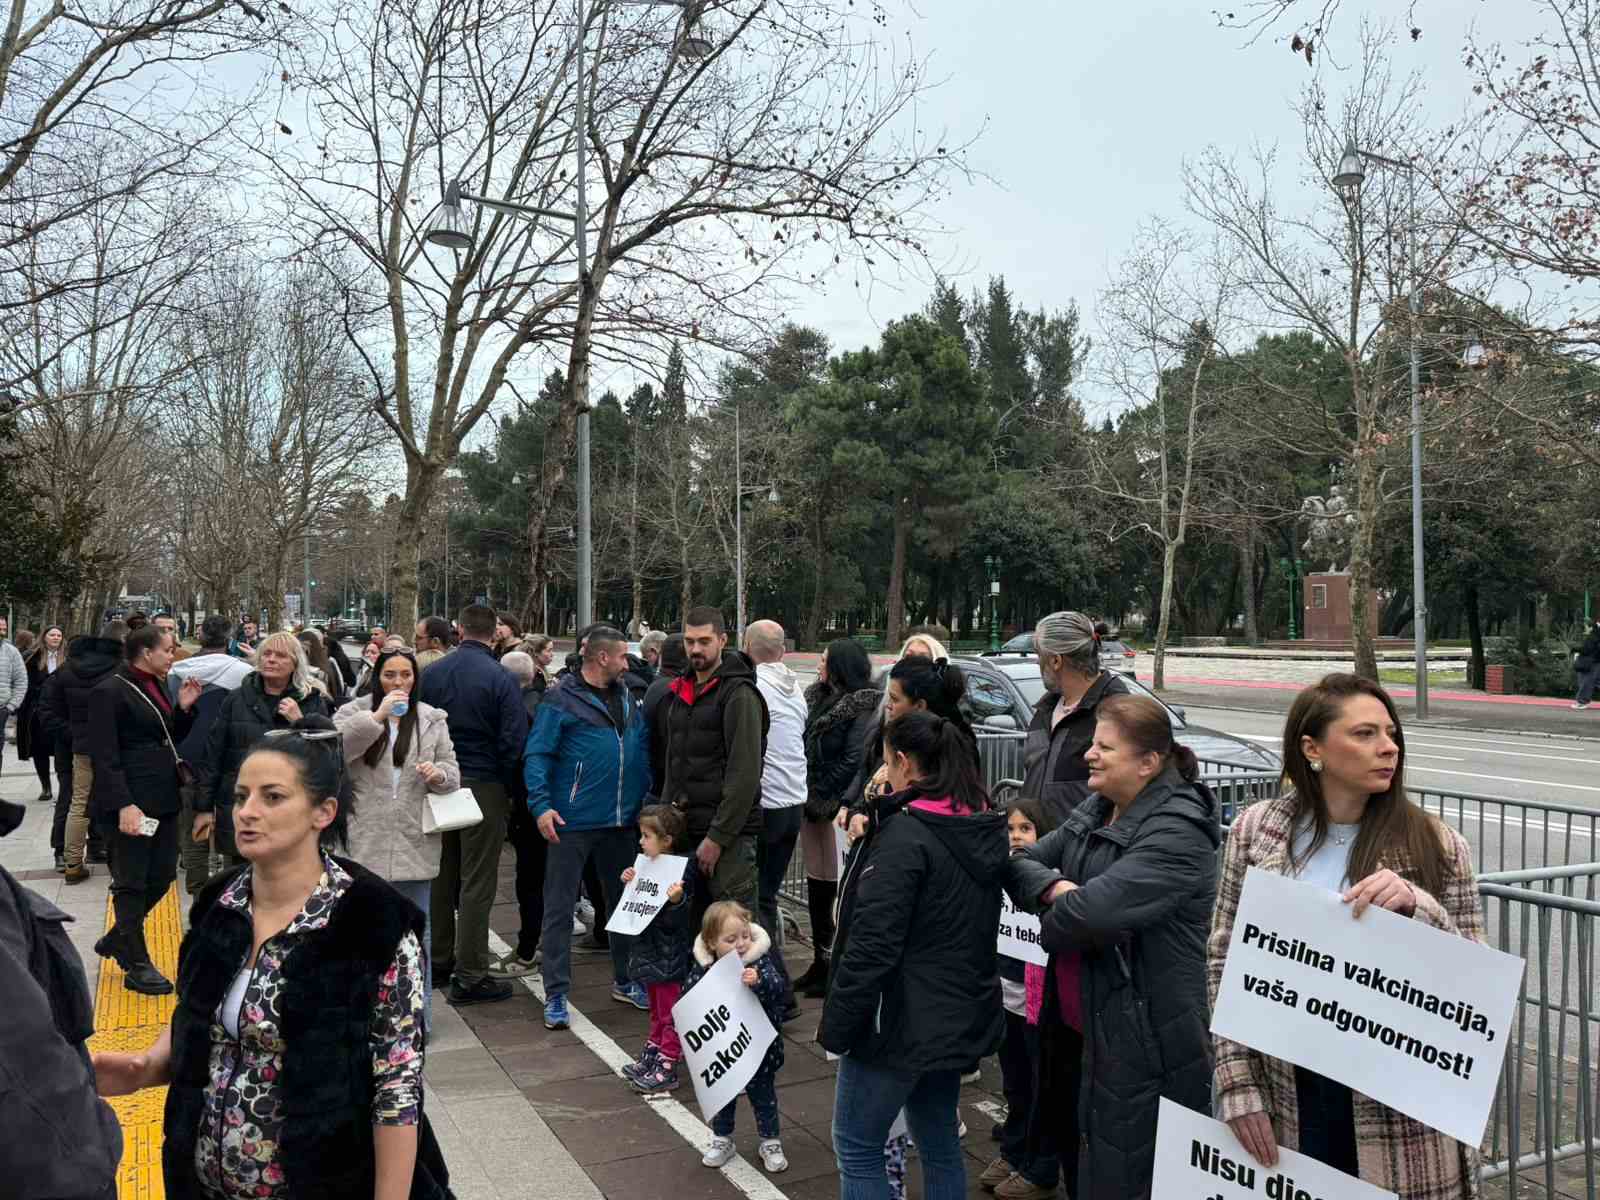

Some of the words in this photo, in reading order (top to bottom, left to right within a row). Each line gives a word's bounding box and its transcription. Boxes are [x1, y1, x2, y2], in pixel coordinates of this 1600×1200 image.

[1242, 923, 1336, 973] Prisilna
[1344, 961, 1496, 1042] vakcinacija,
[684, 1004, 730, 1053] Dolje
[700, 1021, 752, 1088] zakon!
[1243, 973, 1299, 1009] vaša
[1306, 998, 1474, 1080] odgovornost!
[1190, 1139, 1256, 1190] Nisu
